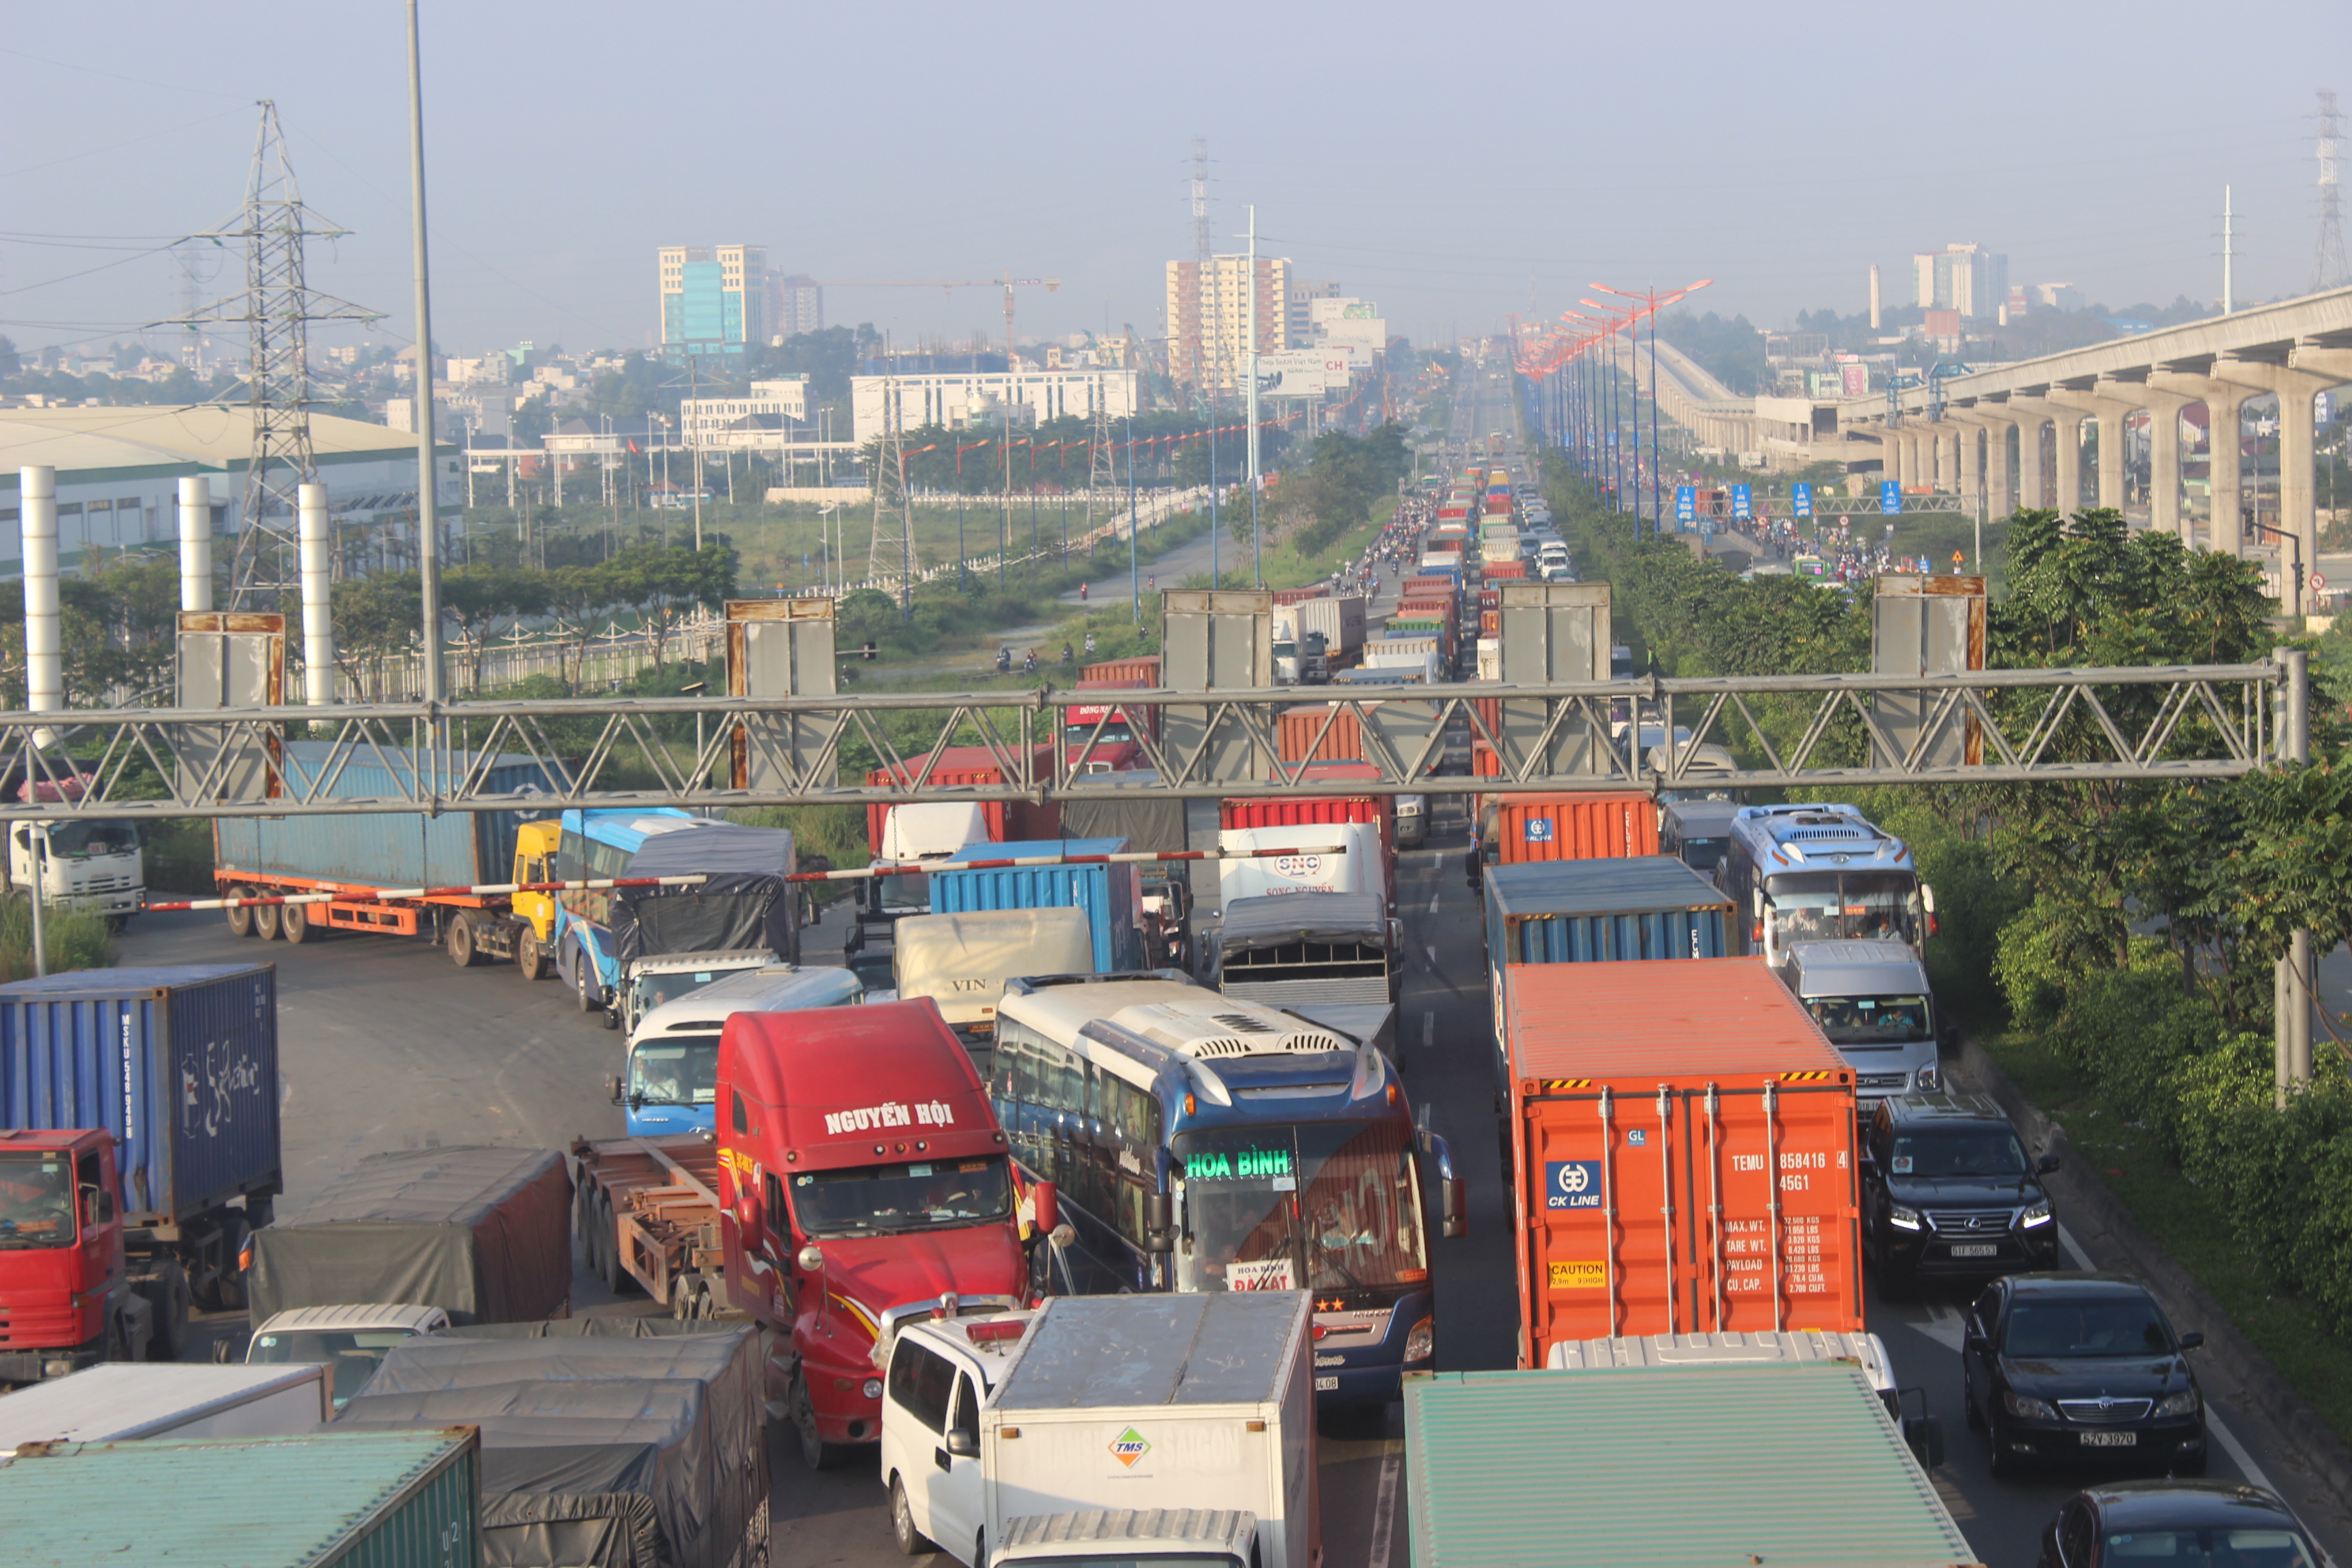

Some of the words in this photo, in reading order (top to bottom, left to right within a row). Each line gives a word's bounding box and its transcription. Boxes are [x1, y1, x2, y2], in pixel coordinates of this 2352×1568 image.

[1279, 858, 1318, 869] SNC
[952, 979, 986, 992] VIN
[122, 1014, 131, 1059] MSKU
[824, 1102, 911, 1135] NGUYỄN
[915, 1100, 954, 1128] HỘI
[1628, 1130, 1644, 1141] GL
[1186, 1152, 1231, 1178] HOA
[1237, 1144, 1289, 1175] BÌNH
[1732, 1154, 1763, 1171] TEMU
[1780, 1152, 1825, 1169] 858416
[1838, 1152, 1846, 1168] 4
[1780, 1174, 1809, 1191] 45G1
[1548, 1196, 1567, 1207] CK
[1570, 1195, 1599, 1206] LINE
[1725, 1222, 1748, 1232] MAX.
[1750, 1220, 1765, 1232] WT.
[1726, 1241, 1746, 1252] TARE
[1750, 1239, 1766, 1252] WT.
[1808, 1235, 1820, 1243] KGS
[1552, 1264, 1603, 1275] CAUTION
[1727, 1259, 1763, 1271] PAYLOAD
[1744, 1278, 1761, 1290] CAP.
[1117, 1442, 1143, 1452] TMS
